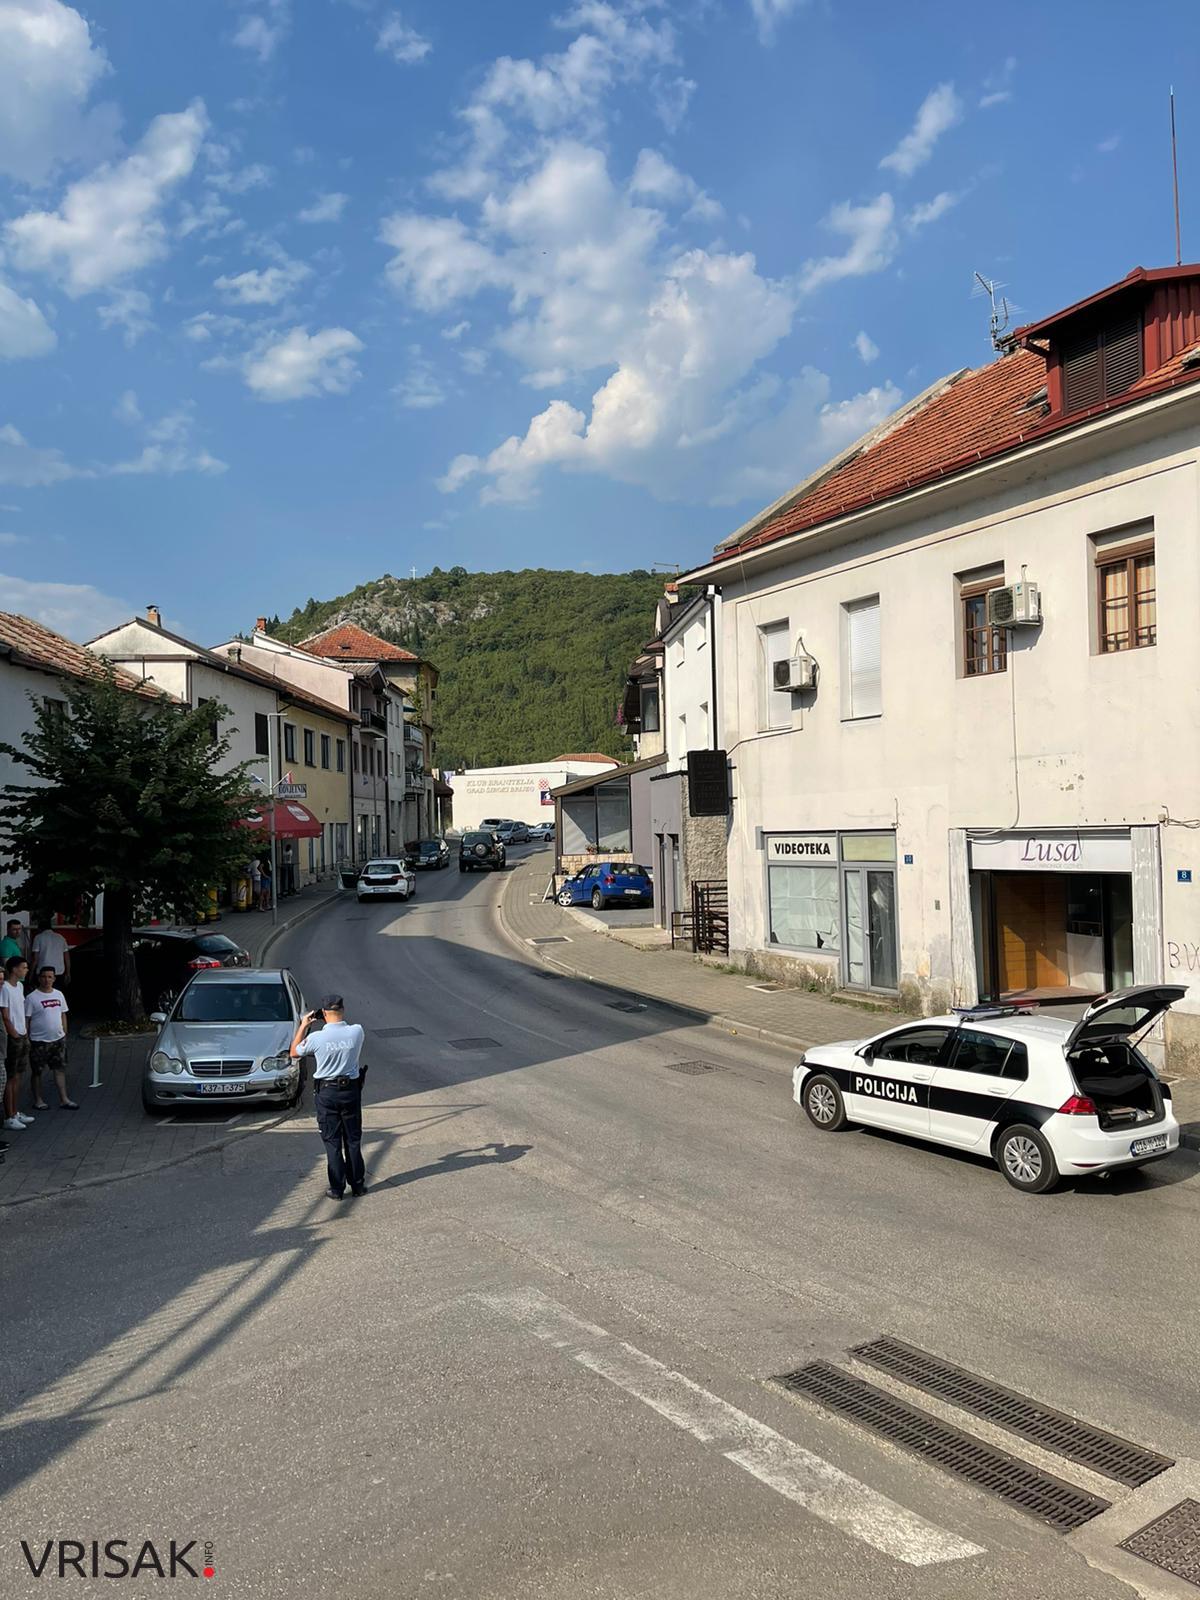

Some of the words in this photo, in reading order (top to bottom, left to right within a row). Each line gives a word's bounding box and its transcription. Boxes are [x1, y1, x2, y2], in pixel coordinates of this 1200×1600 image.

[774, 842, 831, 855] VIDEOTEKA
[1021, 837, 1080, 862] Lusa
[1181, 871, 1187, 879] 8
[855, 1076, 918, 1103] POLICIJA
